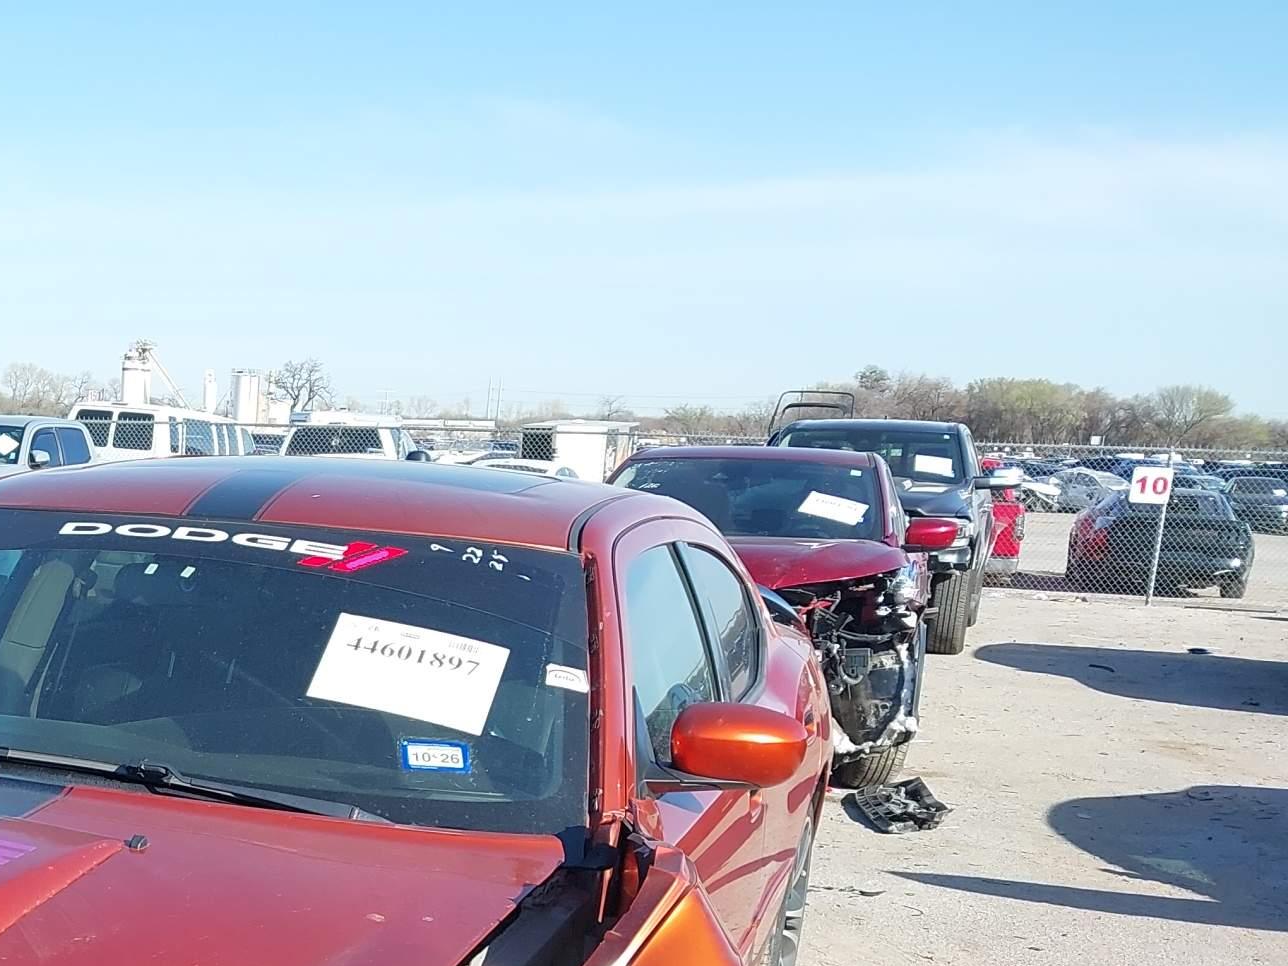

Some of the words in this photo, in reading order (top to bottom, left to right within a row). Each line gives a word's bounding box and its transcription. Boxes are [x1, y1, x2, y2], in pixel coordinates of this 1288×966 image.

[1136, 476, 1168, 494] 10
[59, 522, 349, 560] DODGE
[346, 636, 480, 676] 44601897
